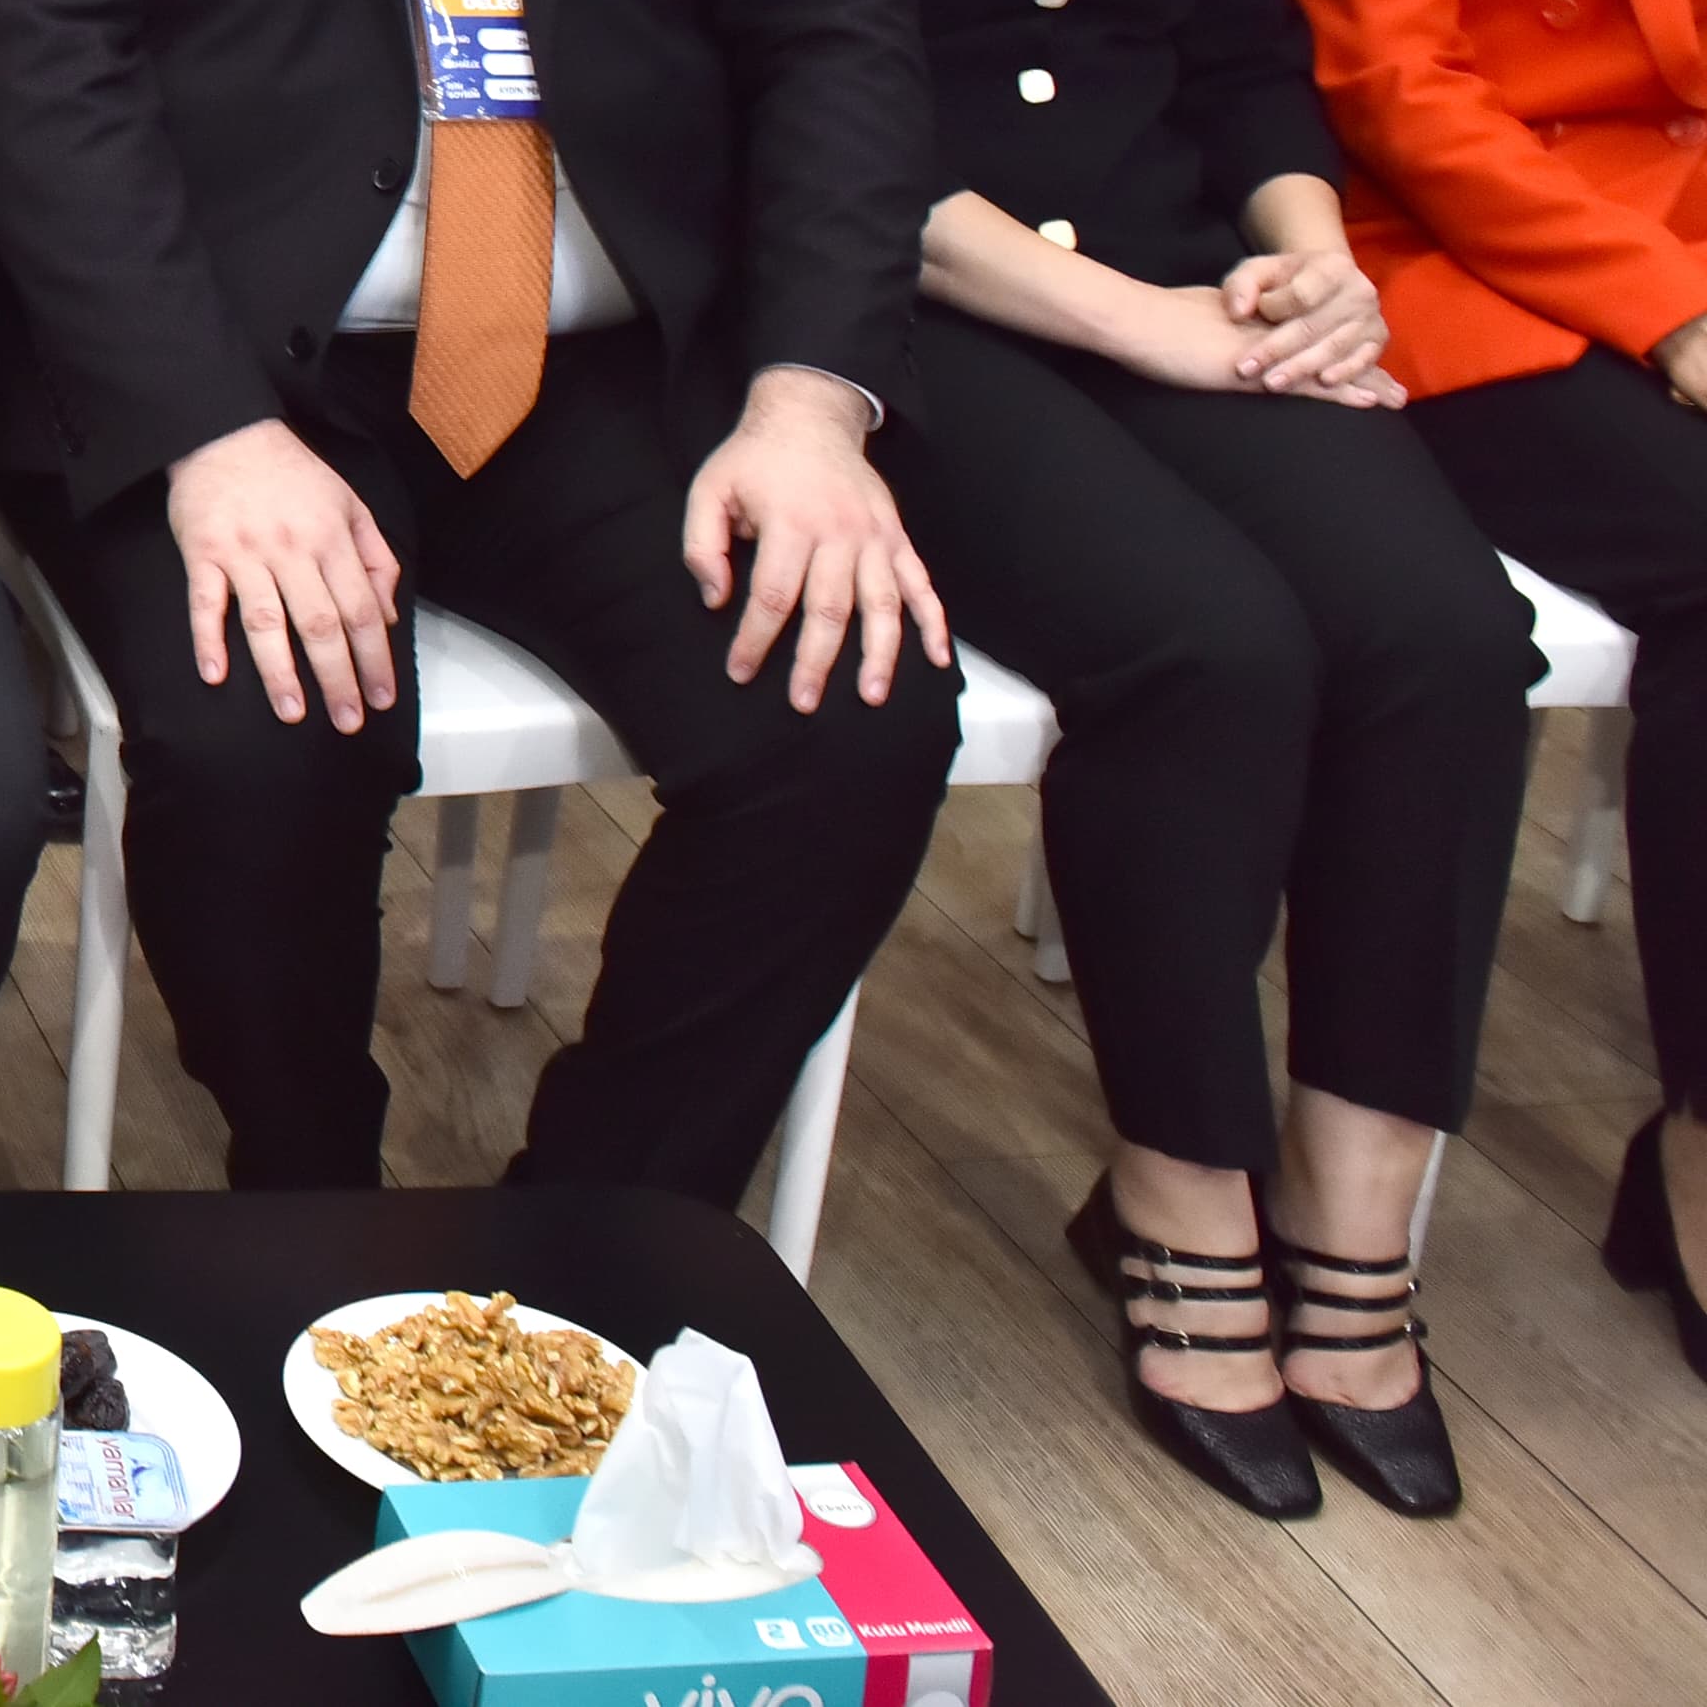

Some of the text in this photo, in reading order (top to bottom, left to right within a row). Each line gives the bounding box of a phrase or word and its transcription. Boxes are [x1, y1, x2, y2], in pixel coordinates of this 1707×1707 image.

[96, 1437, 136, 1520] yamanlar
[766, 1623, 786, 1639] 2
[811, 1622, 845, 1638] 80
[856, 1617, 974, 1640] Kutu Mendil
